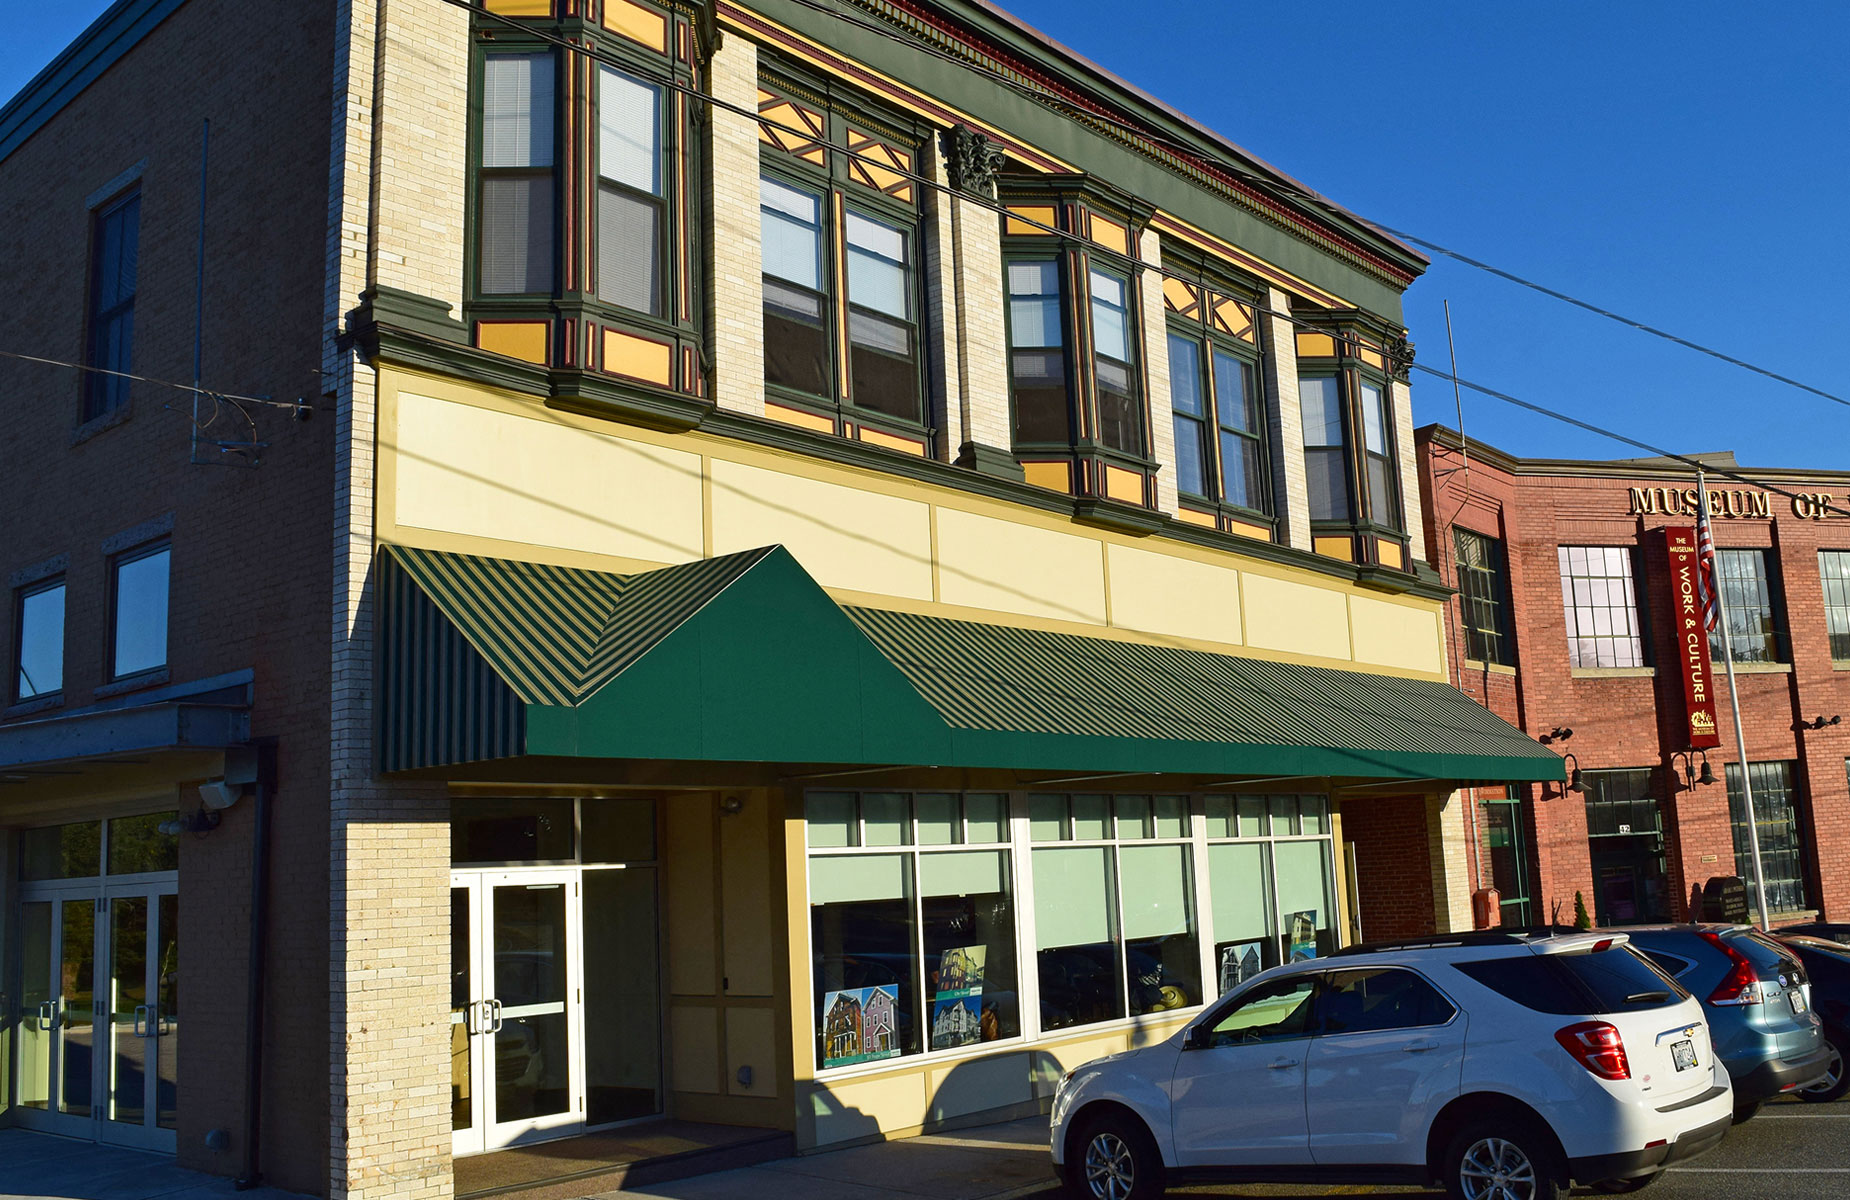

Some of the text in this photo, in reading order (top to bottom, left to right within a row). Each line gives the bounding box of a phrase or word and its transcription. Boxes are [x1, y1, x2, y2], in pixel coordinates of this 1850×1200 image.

[1631, 487, 1833, 519] MUSEUM OF
[1675, 537, 1687, 545] THE
[1678, 554, 1688, 562] OF
[1680, 566, 1706, 703] WORK & CULTURE
